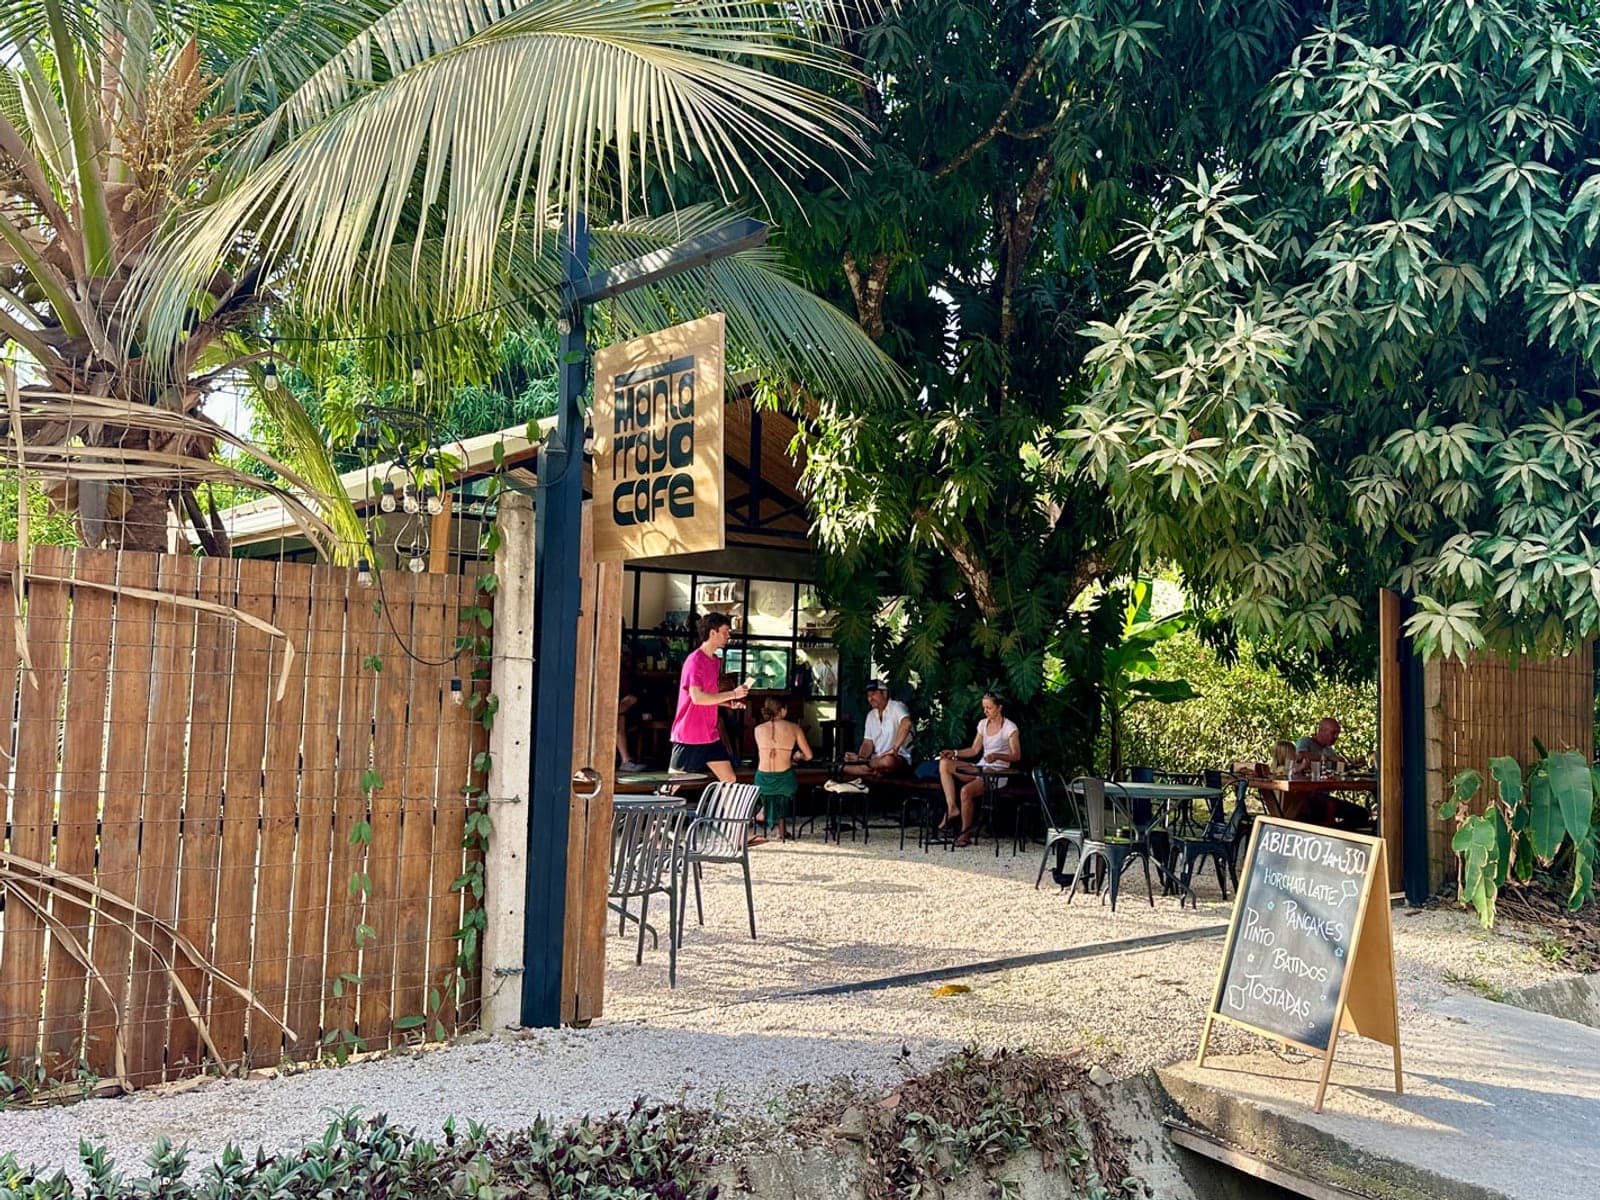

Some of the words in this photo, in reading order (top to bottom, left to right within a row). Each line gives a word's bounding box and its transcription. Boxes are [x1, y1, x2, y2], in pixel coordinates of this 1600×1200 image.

[1259, 831, 1323, 862] ABIERTO
[1264, 868, 1307, 898] HORCHATA
[1307, 878, 1339, 907] LATTE
[1243, 907, 1275, 946] PINTO
[1282, 900, 1344, 942] PANCAKES
[1272, 948, 1328, 983] BATIDOS
[1245, 973, 1312, 1022] TOSTADAS
